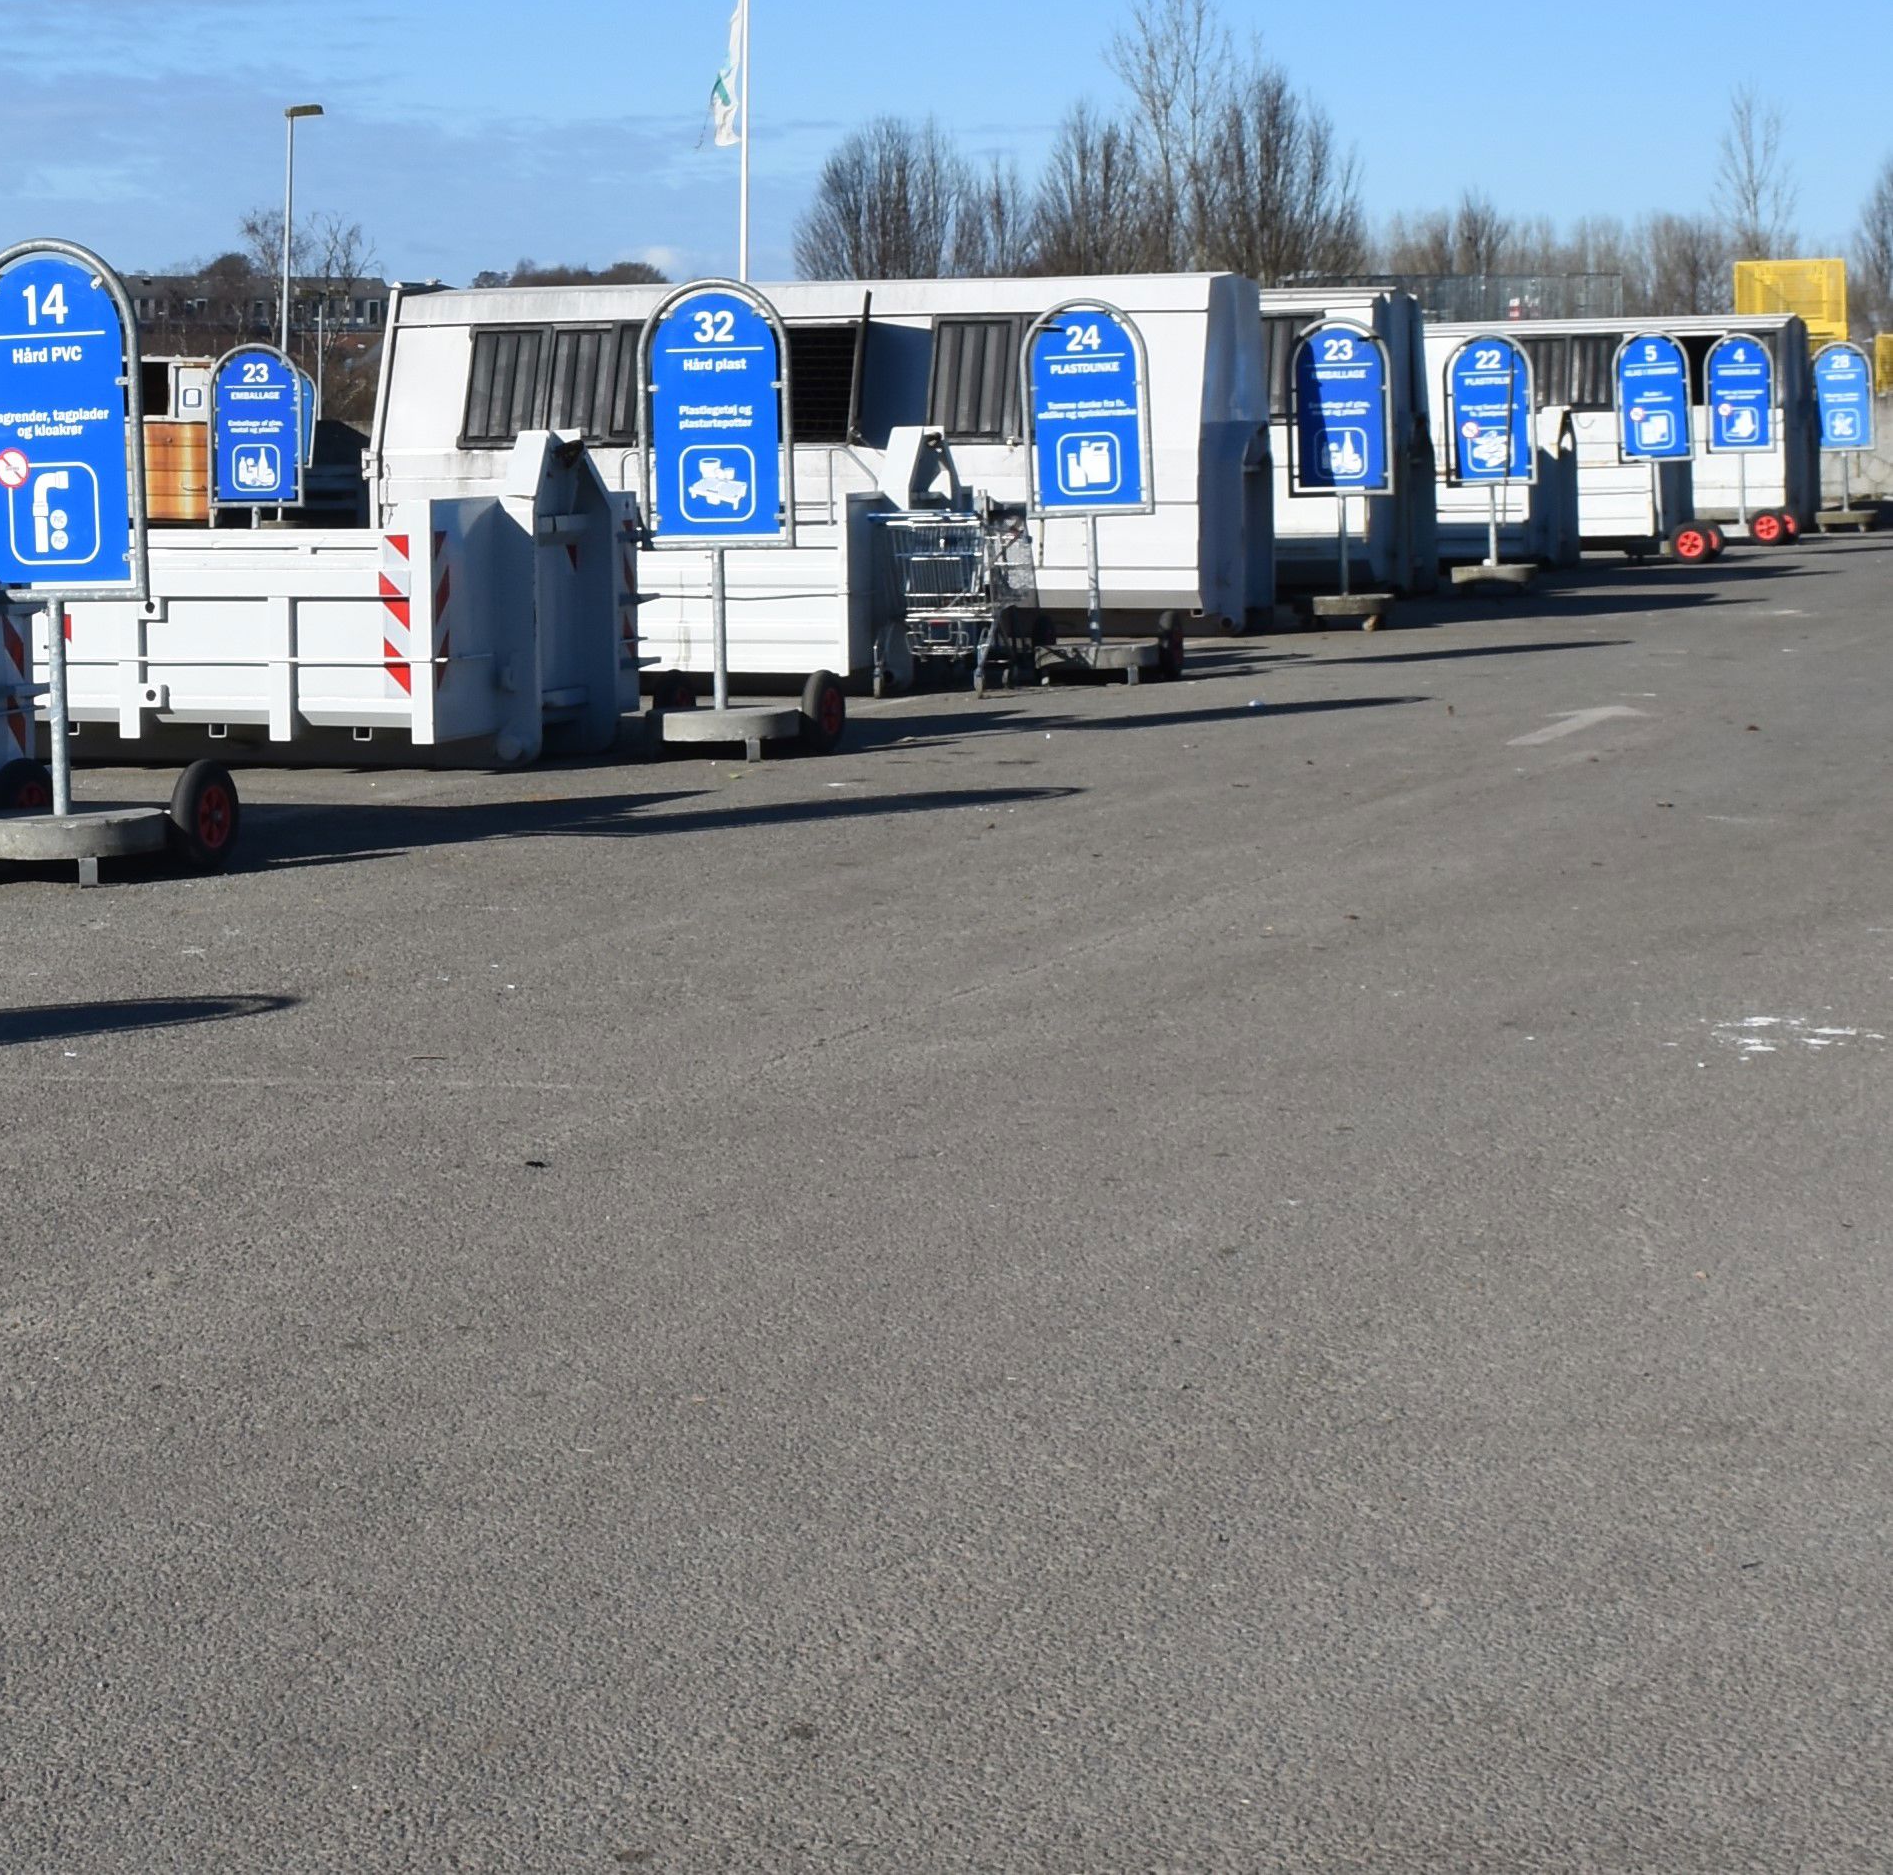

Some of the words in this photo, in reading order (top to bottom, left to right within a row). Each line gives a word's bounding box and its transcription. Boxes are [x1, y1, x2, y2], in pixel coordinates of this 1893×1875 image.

[22, 283, 68, 326] 14
[694, 310, 734, 342] 32
[1066, 325, 1101, 351] 24
[12, 347, 48, 364] Hård
[51, 345, 82, 362] PVC
[1323, 339, 1353, 361] 23
[1645, 345, 1657, 362] 5
[1733, 348, 1746, 363] 4
[683, 358, 713, 371] Hård
[715, 358, 747, 372] plast
[1050, 361, 1120, 375] PLASTDUNKE
[1475, 350, 1501, 369] 22
[243, 363, 269, 383] 23
[230, 391, 280, 400] EMBALLAGE
[52, 408, 109, 423] tagplader
[17, 426, 33, 439] og
[34, 423, 83, 437] kloakrør
